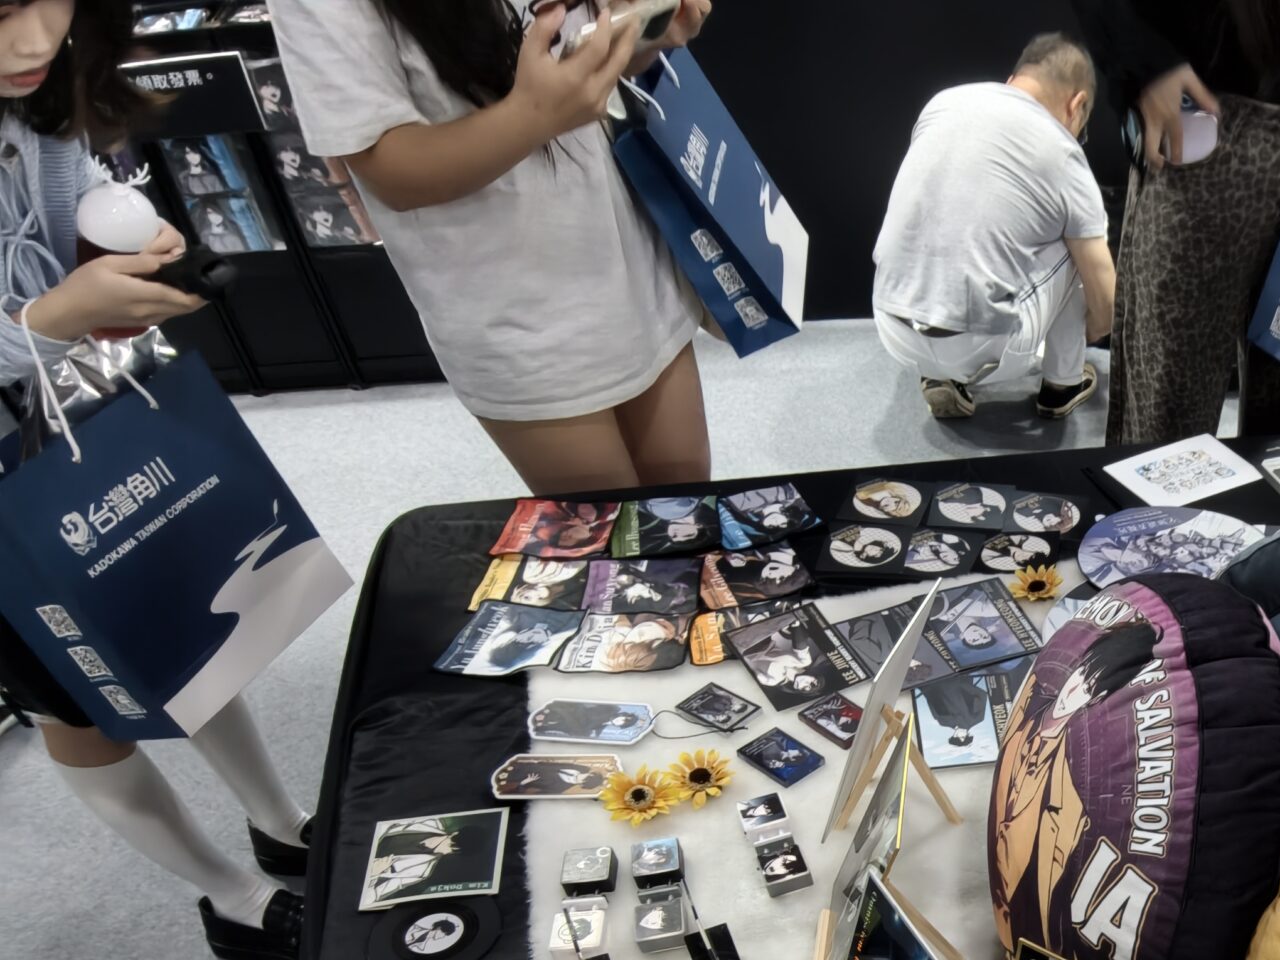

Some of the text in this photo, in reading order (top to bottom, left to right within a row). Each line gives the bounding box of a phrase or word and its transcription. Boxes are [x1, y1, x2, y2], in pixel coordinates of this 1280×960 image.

[127, 69, 213, 90] 領取發票。
[89, 456, 176, 535] 台灣角川
[87, 474, 221, 579] KADOKAWA TAIWAN CORPORATION
[826, 650, 860, 685] LEE JIHYE
[1023, 637, 1038, 651] LEE
[1129, 689, 1176, 857] SALVATION
